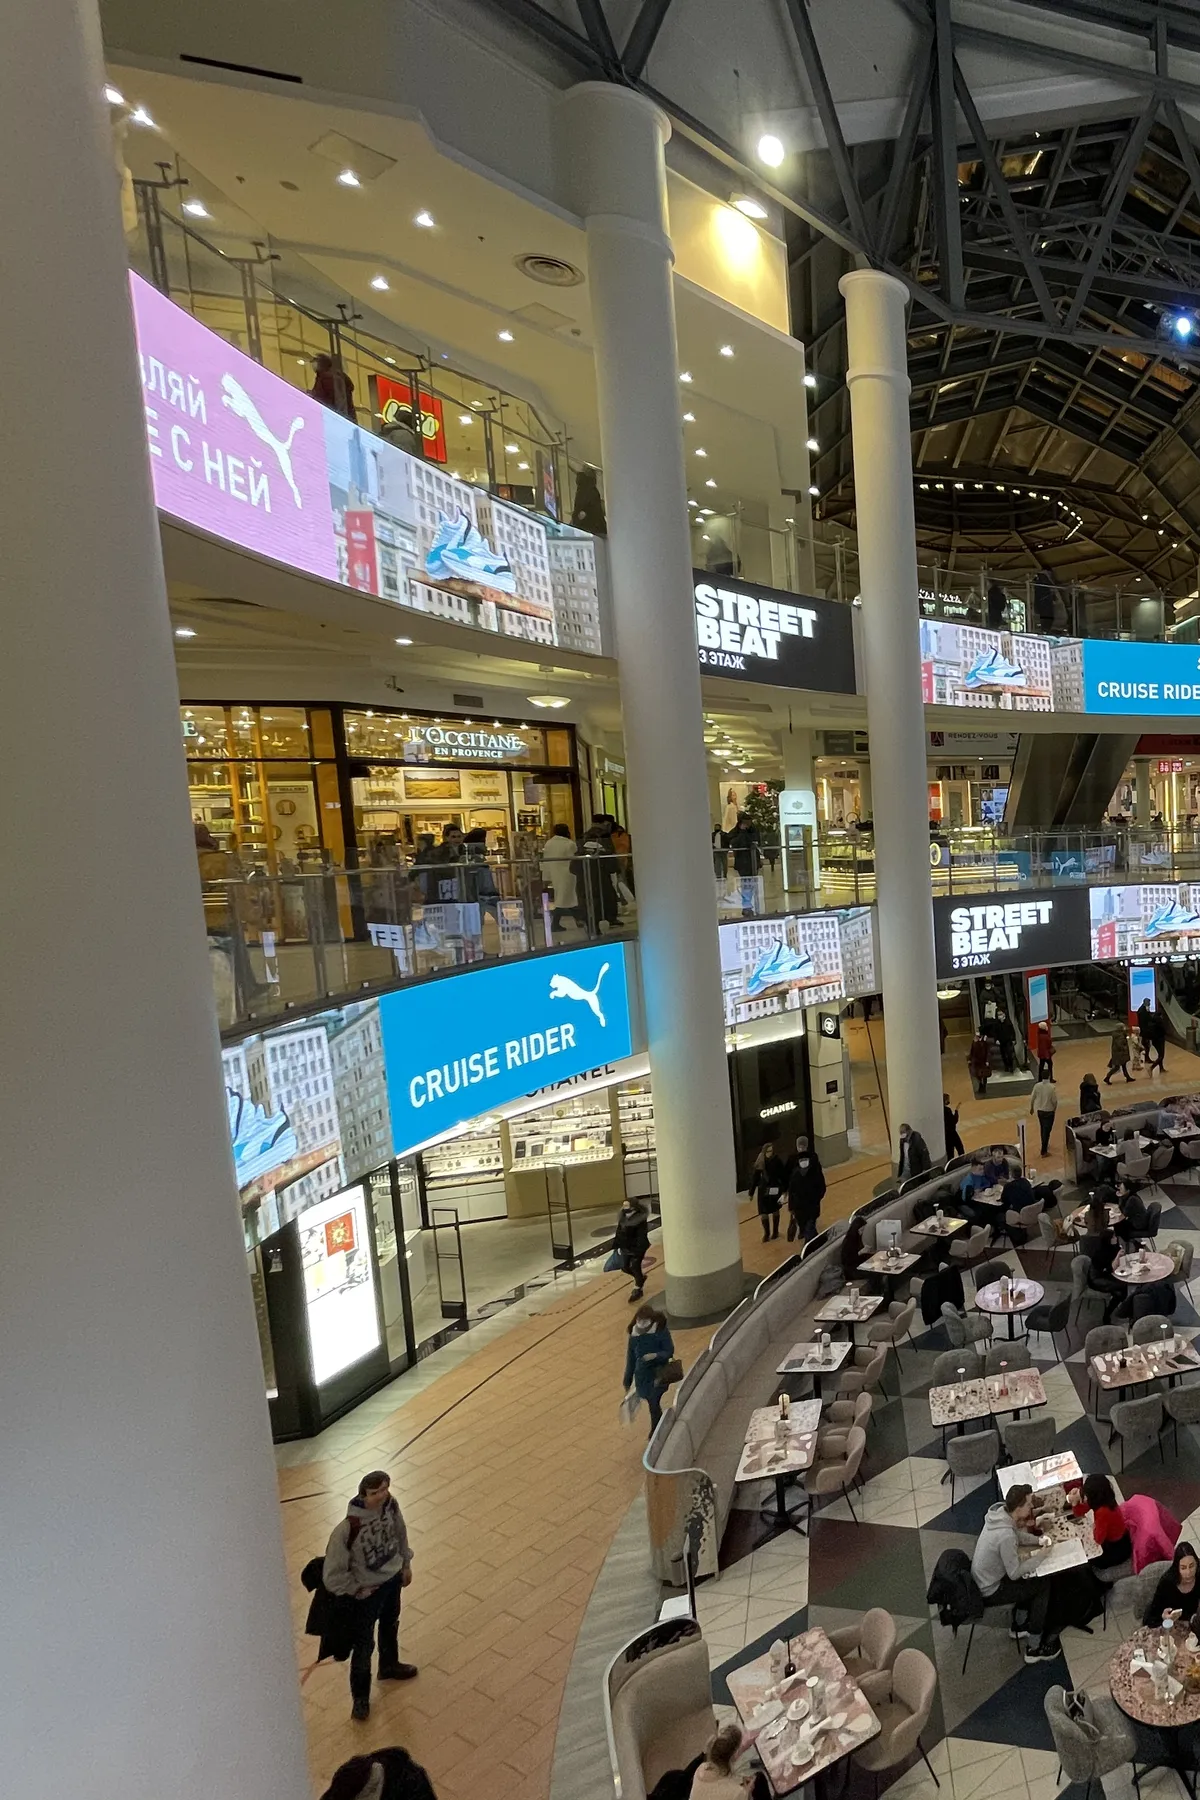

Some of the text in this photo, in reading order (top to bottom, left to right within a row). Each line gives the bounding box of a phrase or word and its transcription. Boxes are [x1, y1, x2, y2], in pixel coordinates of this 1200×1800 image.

[171, 425, 193, 472] С
[202, 440, 271, 513] НЕЙ
[695, 583, 817, 638] STREET
[697, 614, 781, 660] BEAT
[699, 649, 746, 670] 3 ЭТАЖ
[1097, 681, 1159, 699] CRUISE
[435, 747, 503, 758] EN PROVENCE
[951, 901, 1053, 932] STREET
[952, 926, 1021, 956] BEAT
[952, 954, 990, 969] 3 ЭТАЖ
[409, 1023, 577, 1109] CRUISE RIDER
[760, 1101, 798, 1119] CHANEL
